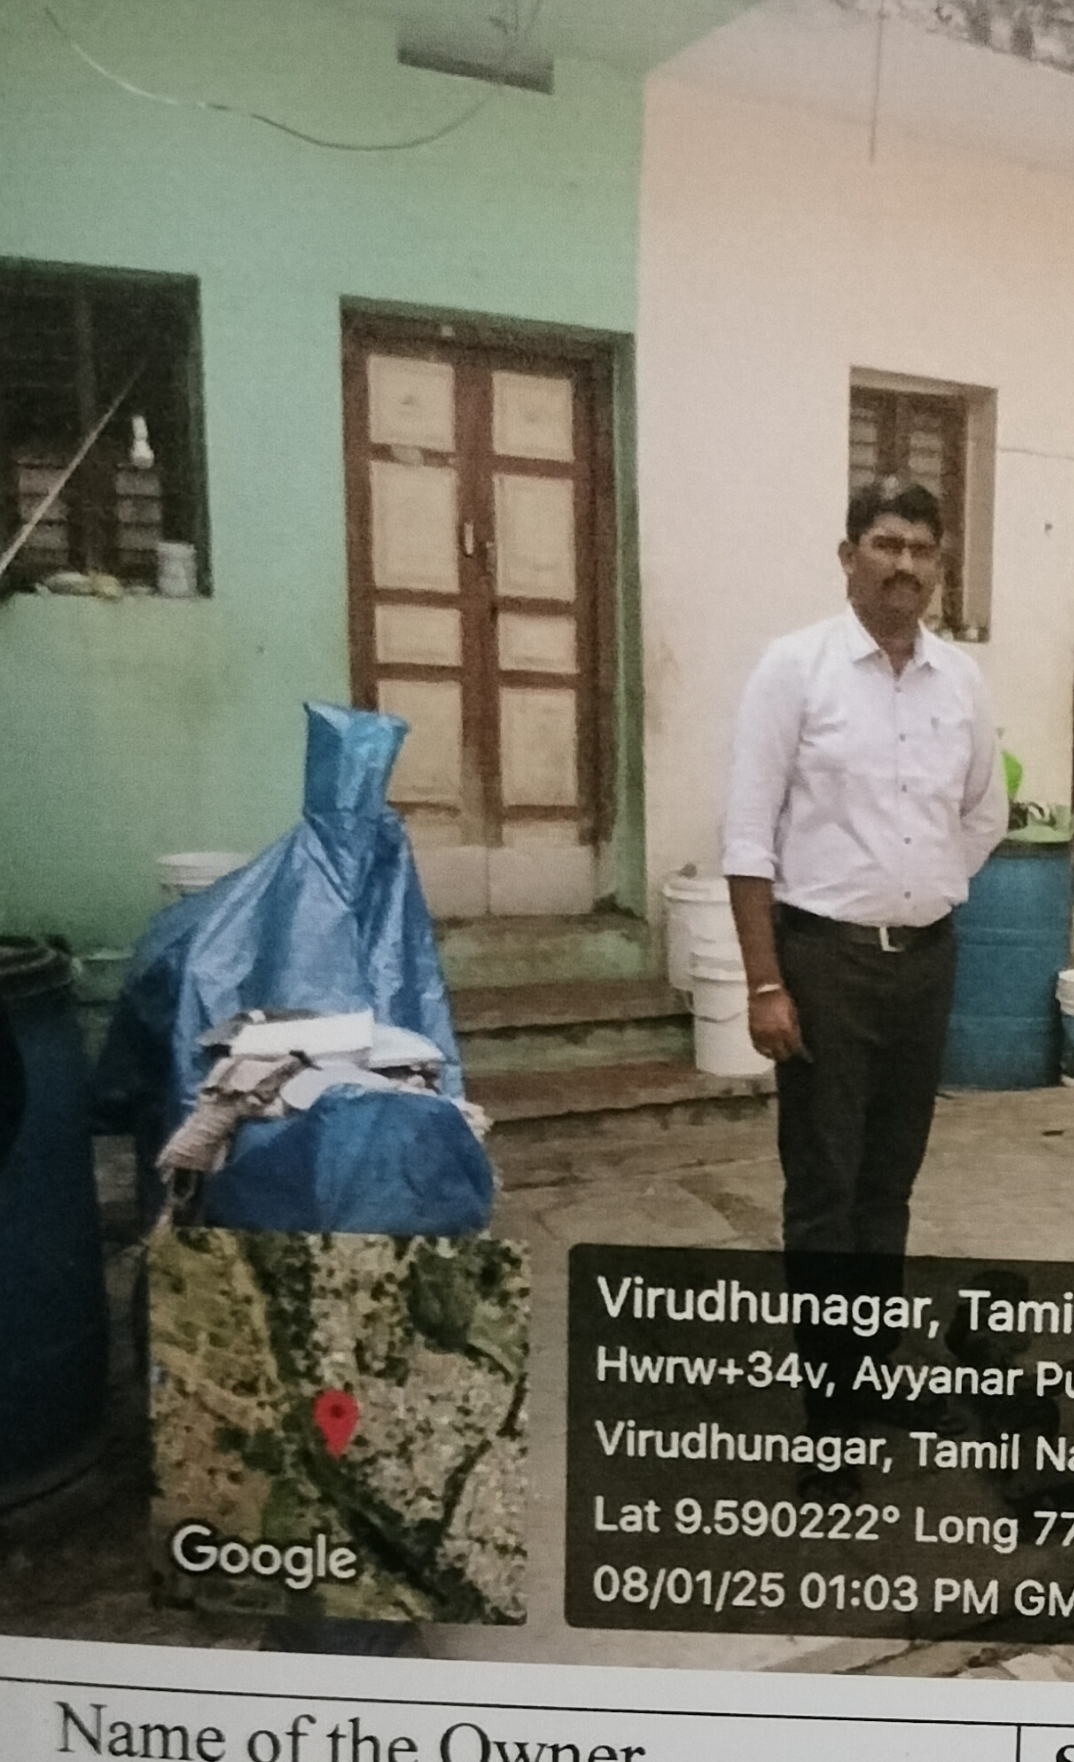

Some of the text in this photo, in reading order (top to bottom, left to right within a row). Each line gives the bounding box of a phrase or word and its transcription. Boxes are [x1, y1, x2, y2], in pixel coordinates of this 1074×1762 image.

[56, 1701, 226, 1761] Name
[247, 1714, 317, 1762] of
[327, 1718, 418, 1762] the
